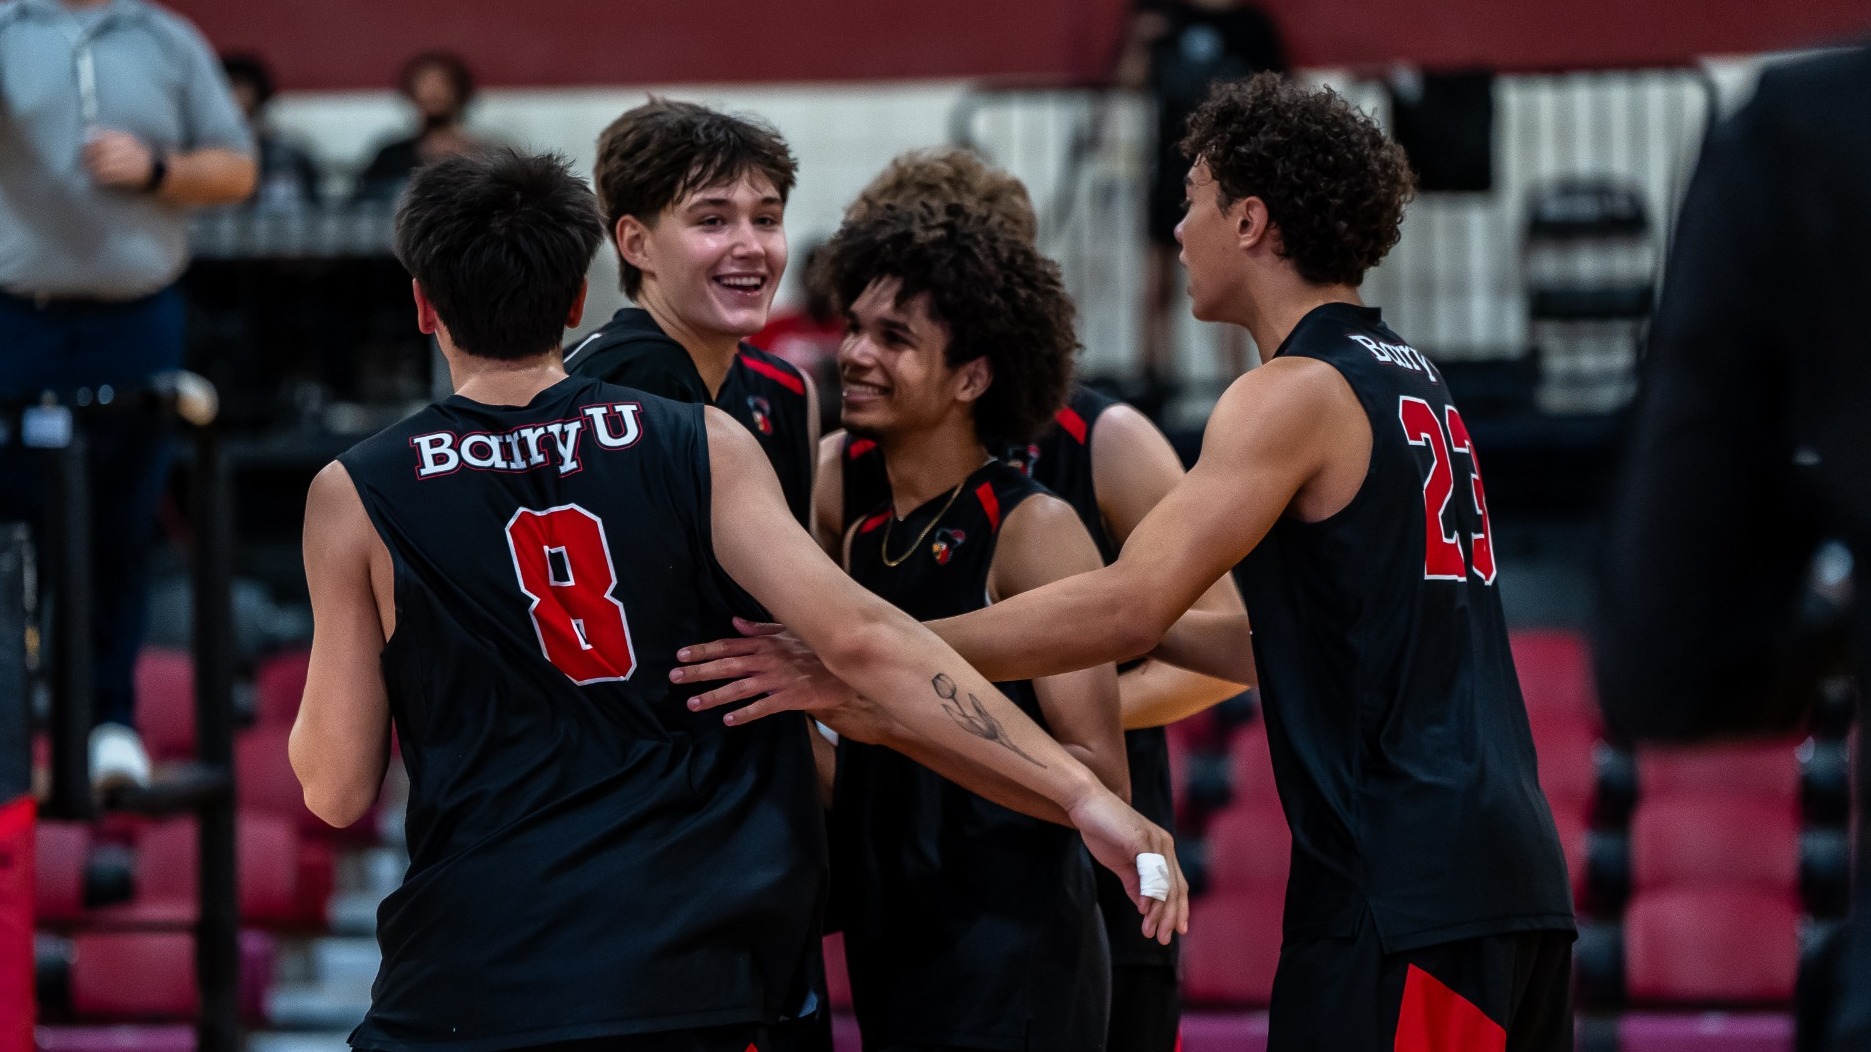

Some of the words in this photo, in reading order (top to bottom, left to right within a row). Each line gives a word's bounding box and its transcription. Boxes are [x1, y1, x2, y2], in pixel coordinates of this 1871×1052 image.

[1346, 334, 1438, 383] Barry
[411, 418, 584, 478] Barry
[581, 402, 642, 449] U
[1399, 395, 1497, 586] 23
[504, 502, 638, 686] 8
